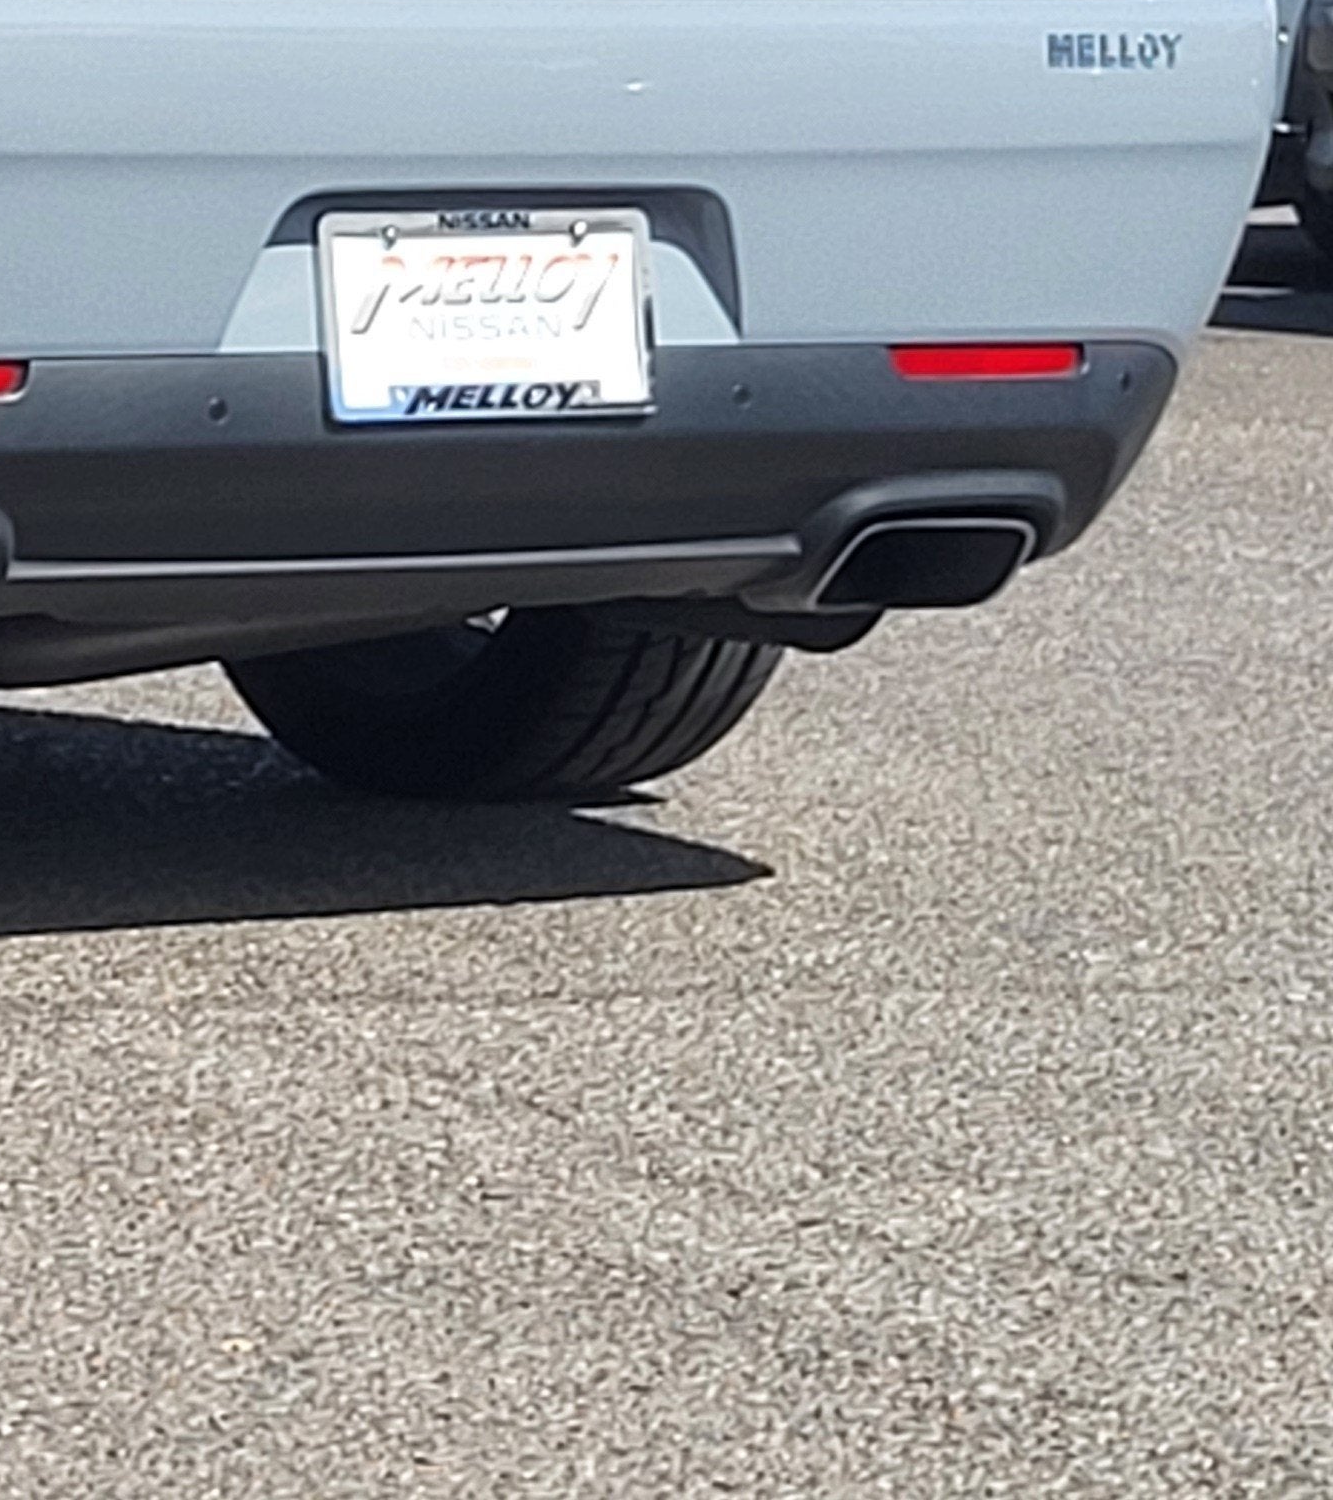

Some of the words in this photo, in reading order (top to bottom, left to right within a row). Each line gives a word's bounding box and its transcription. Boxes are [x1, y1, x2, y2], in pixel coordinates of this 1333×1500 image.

[1047, 33, 1182, 69] MELLOY
[437, 213, 532, 230] NISSAN
[351, 253, 620, 335] MELLOY
[409, 314, 562, 342] NISSAN
[403, 382, 583, 415] MELLOY
